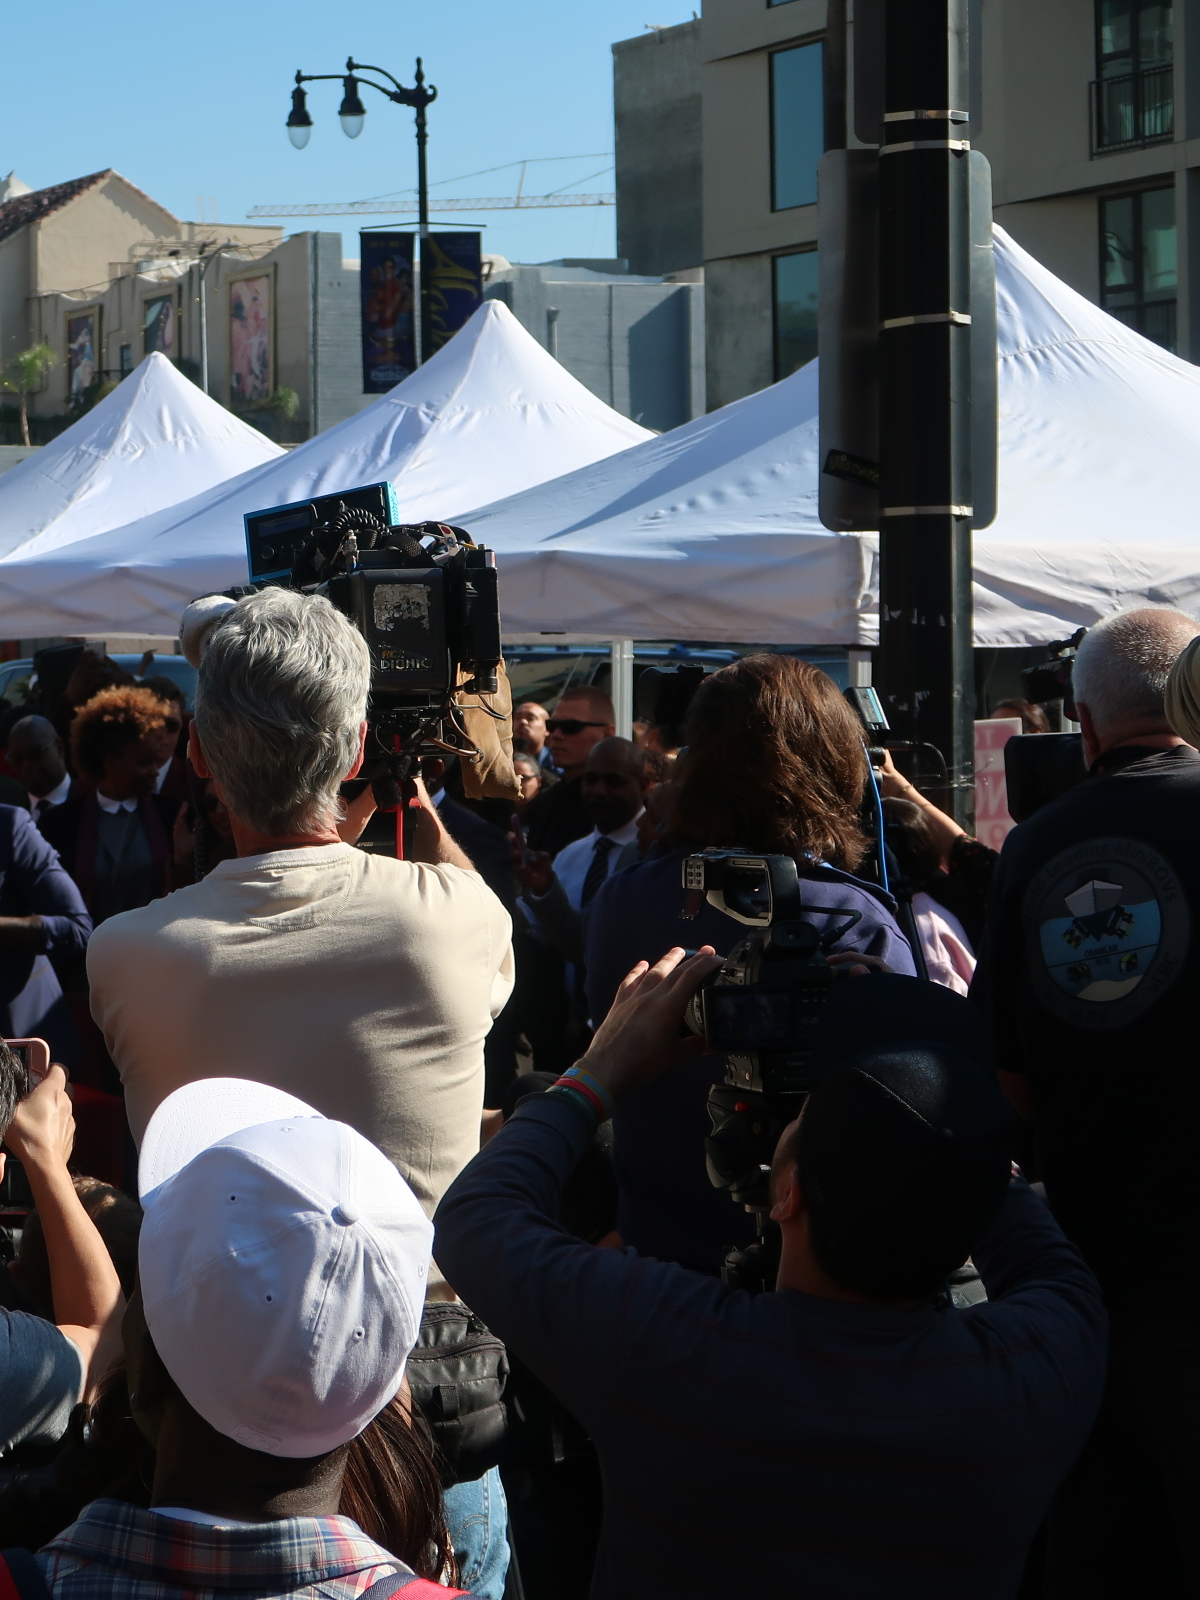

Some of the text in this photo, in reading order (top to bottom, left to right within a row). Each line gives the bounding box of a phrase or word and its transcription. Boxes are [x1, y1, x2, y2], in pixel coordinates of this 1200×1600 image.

[1047, 844, 1110, 879] Leading
[1114, 841, 1178, 903] MiniROVs
[1084, 944, 1119, 957] CRAWLER
